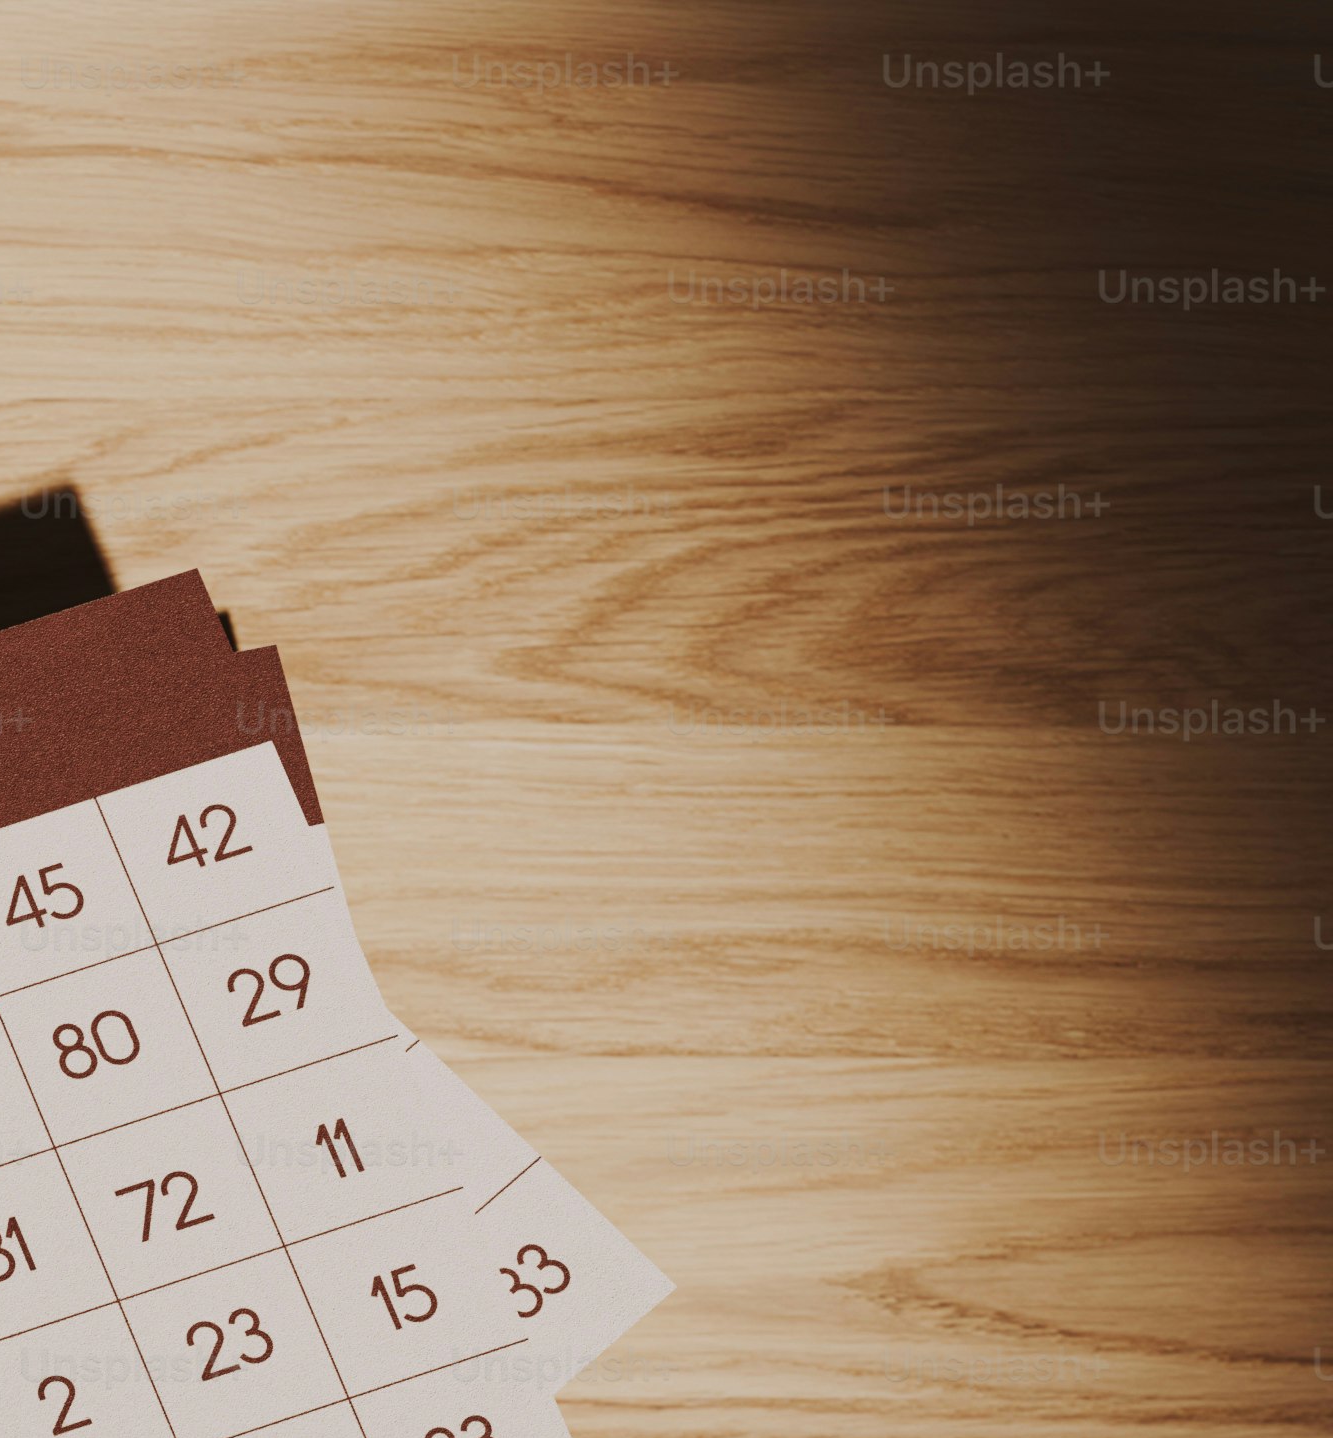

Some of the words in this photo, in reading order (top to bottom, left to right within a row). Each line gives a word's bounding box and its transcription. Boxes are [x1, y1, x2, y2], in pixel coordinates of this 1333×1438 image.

[6, 863, 84, 928] 45
[167, 804, 253, 867] 42
[52, 1010, 140, 1079] 80
[227, 953, 310, 1027] 29
[115, 1171, 215, 1242] 72
[316, 1118, 364, 1178] 11
[37, 1375, 92, 1436] 2
[186, 1308, 273, 1381] 23
[371, 1264, 438, 1330] 15
